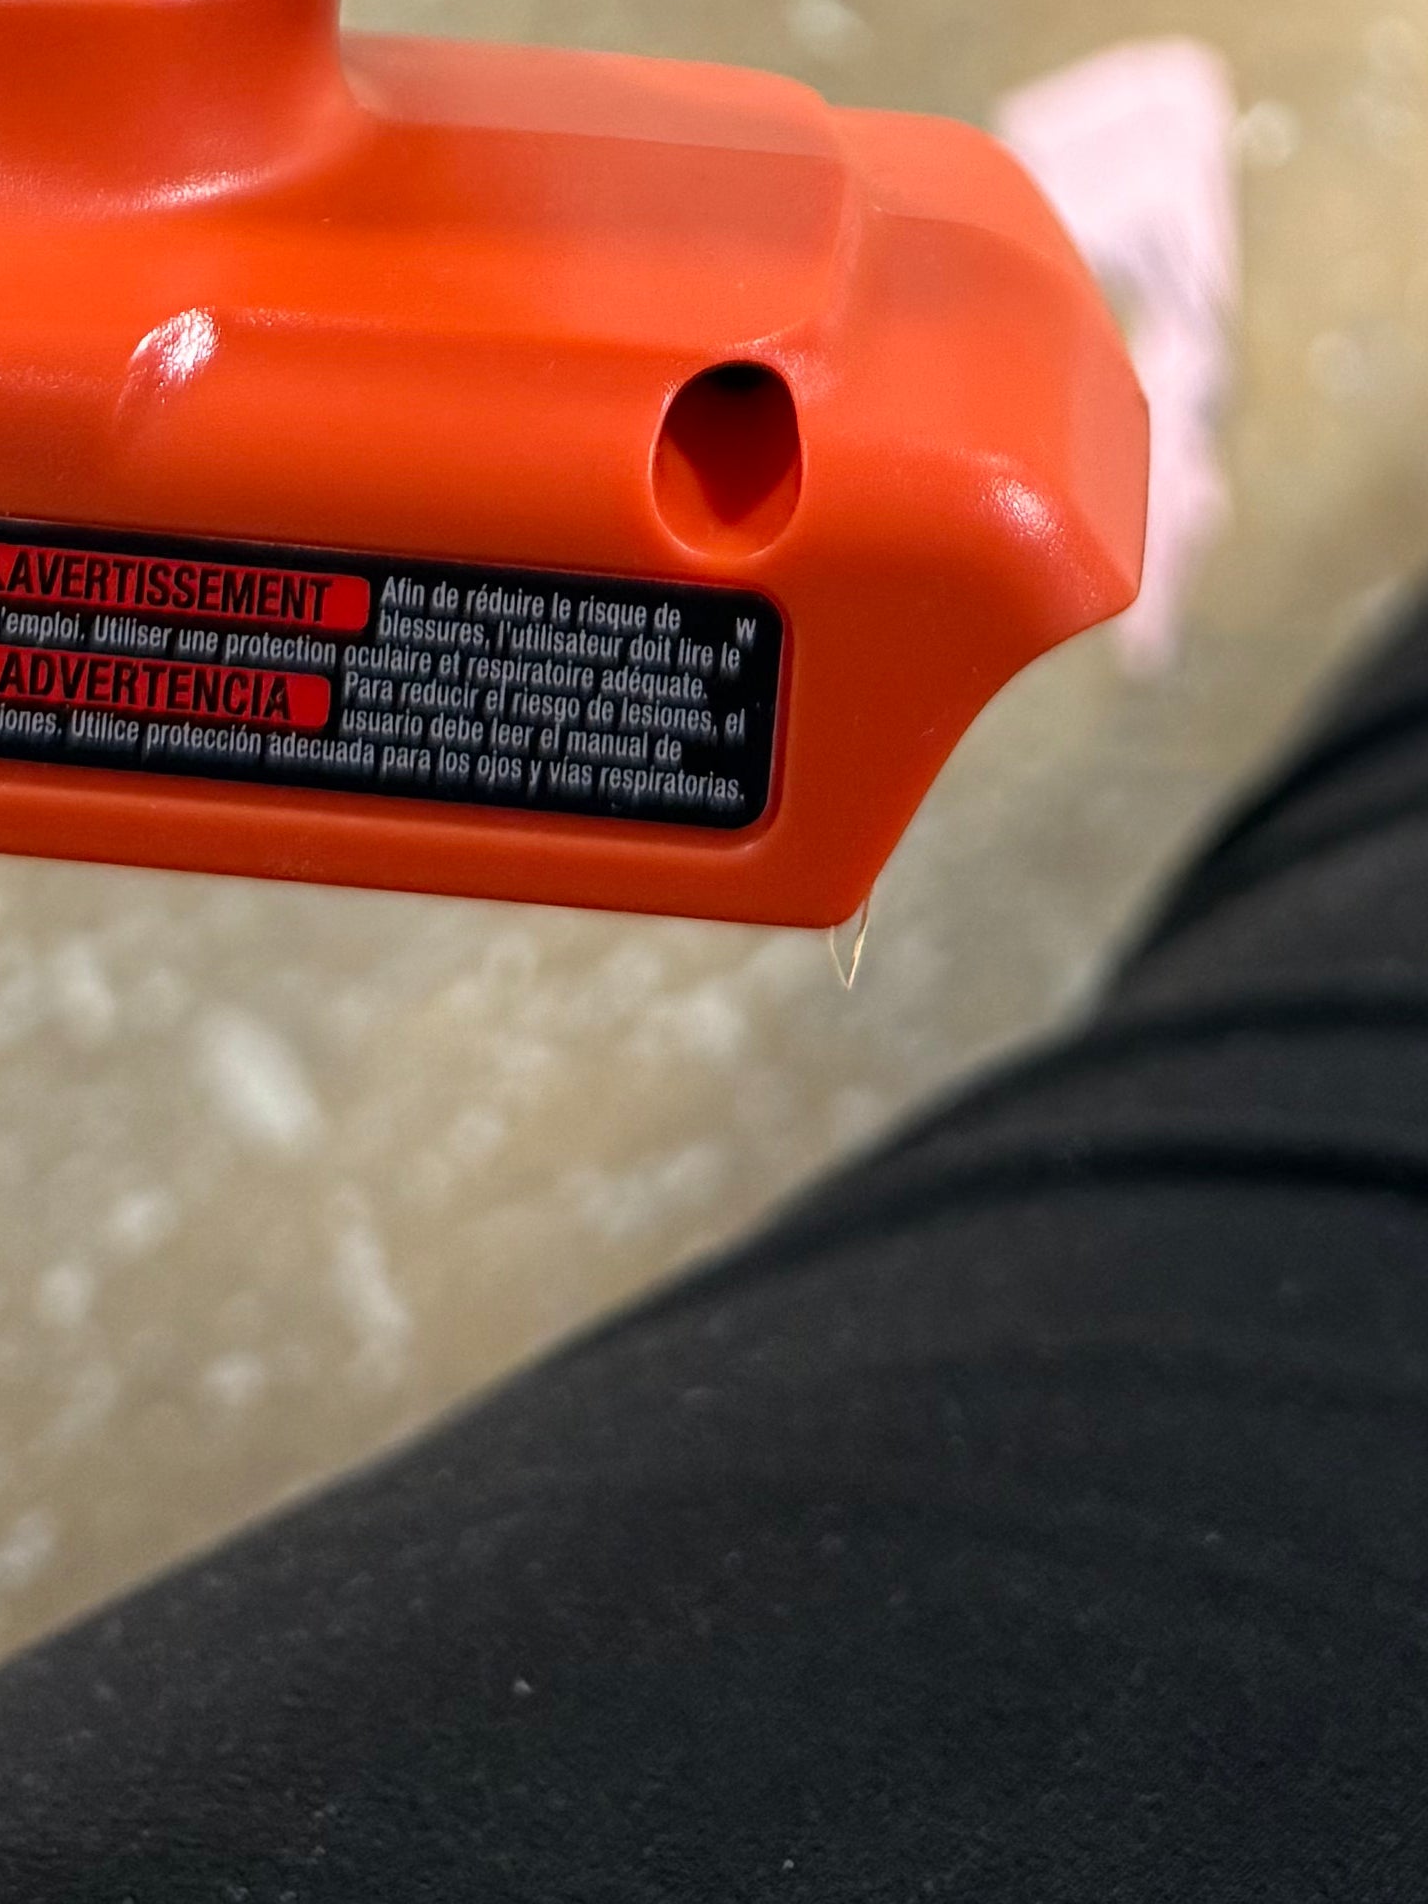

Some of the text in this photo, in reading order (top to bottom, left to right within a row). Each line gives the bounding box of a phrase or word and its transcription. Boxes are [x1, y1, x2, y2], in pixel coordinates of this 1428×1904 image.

[6, 550, 332, 624] AVERTISSEMENT
[380, 576, 681, 631] Afin de réduire le risque de
[95, 614, 172, 648] Utiliser
[178, 628, 219, 652] une
[225, 632, 337, 664] protection
[344, 643, 432, 673] oculaire
[440, 650, 460, 677] et
[468, 654, 594, 689] respiratoire
[601, 665, 708, 700] adéquate.
[379, 609, 740, 670] blessures, l'utilisateur doit lire le
[736, 617, 756, 641] W
[342, 708, 682, 762] usuario debe leer el manual de
[344, 671, 745, 736] Para reducir el riesgo de lesiones, el
[72, 709, 139, 742] Utilice
[146, 721, 261, 755] protección
[269, 733, 374, 765] adecuada
[382, 745, 430, 775] para
[440, 745, 470, 774] los
[478, 750, 522, 784] ojos
[530, 760, 542, 786] y
[550, 756, 592, 785] vías
[600, 765, 744, 800] respiratorias.
